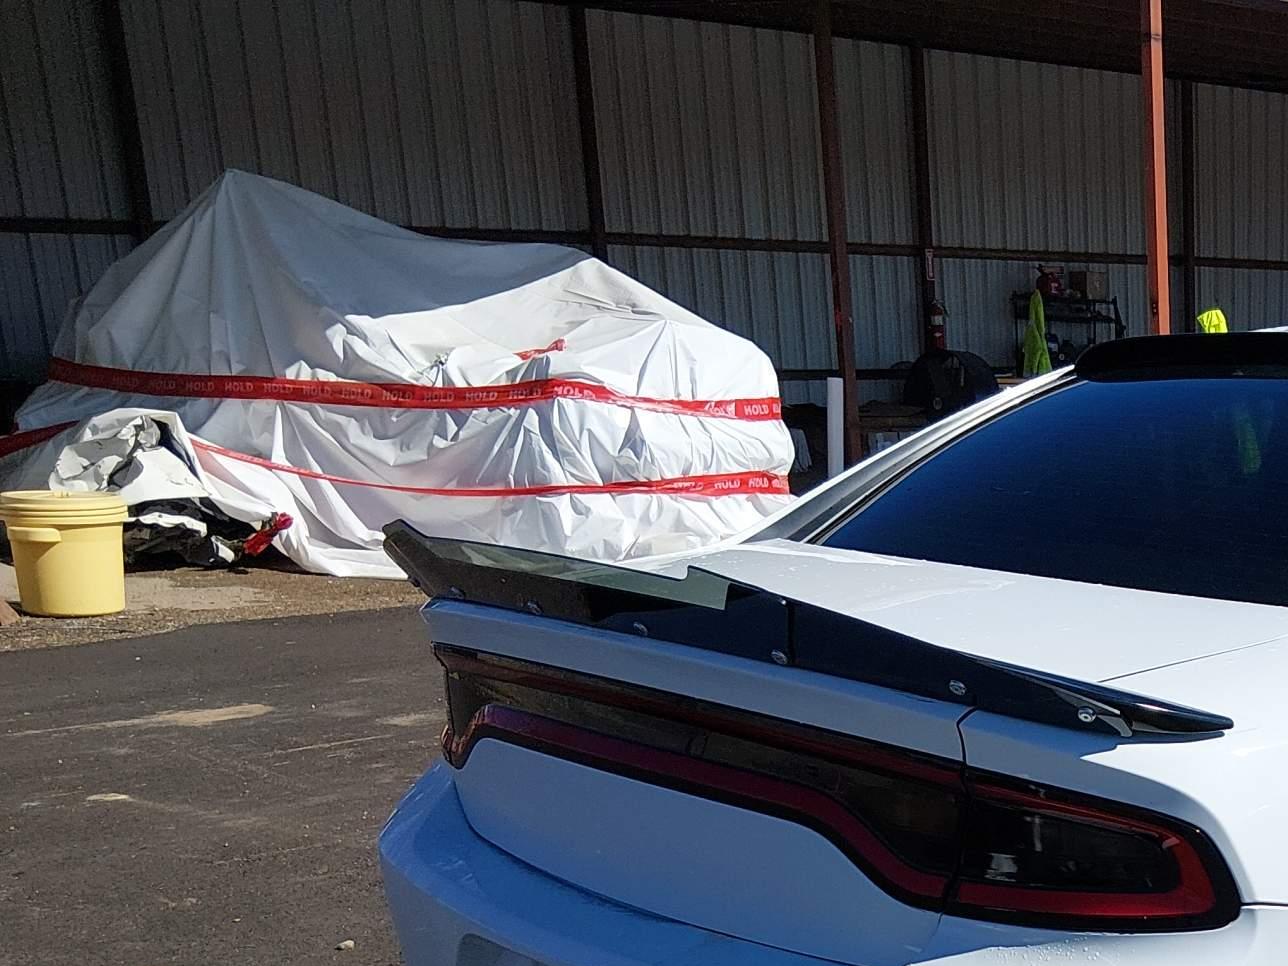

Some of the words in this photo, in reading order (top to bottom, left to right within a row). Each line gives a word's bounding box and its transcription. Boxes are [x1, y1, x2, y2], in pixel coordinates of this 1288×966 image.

[186, 381, 215, 393] HOLD
[224, 381, 254, 393] HOLD
[263, 382, 293, 394] HOLD
[303, 385, 331, 398] HOLD
[342, 386, 372, 400] HOLD
[382, 389, 413, 402] HOLD
[424, 390, 455, 402] HOLD
[465, 390, 498, 402] HOLD
[554, 385, 596, 401] HOLD
[744, 403, 769, 416] HOLD
[748, 477, 770, 488] HOLD
